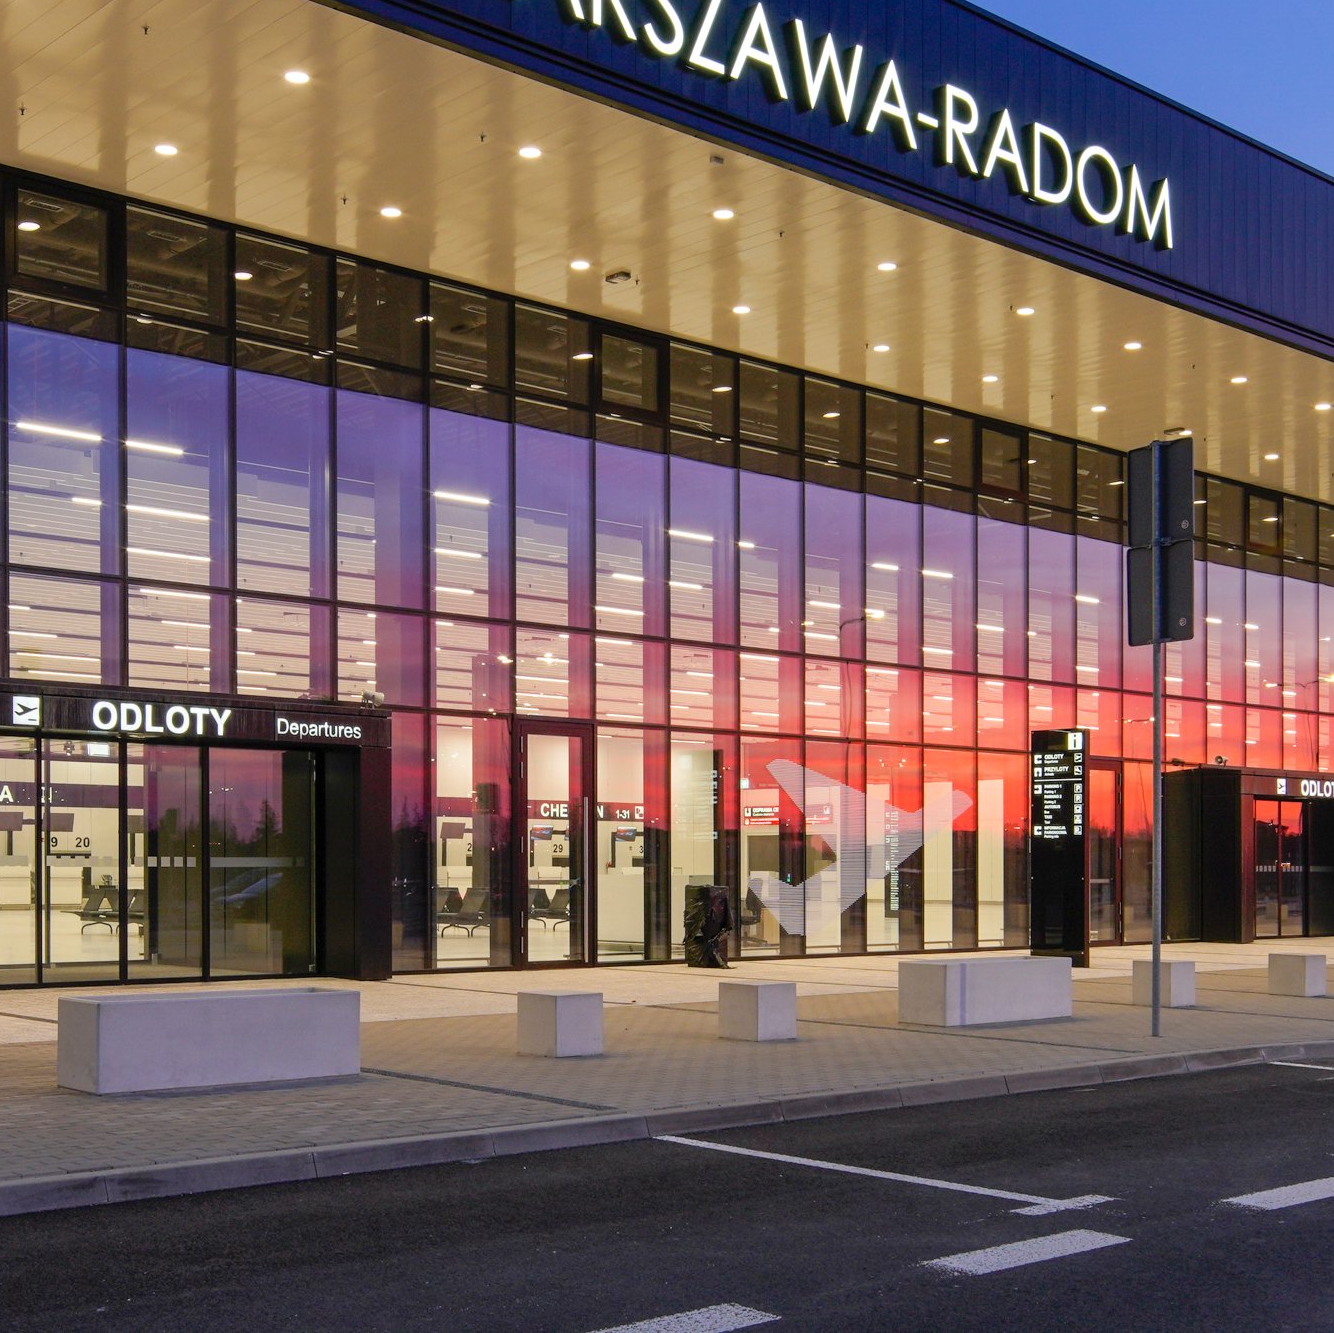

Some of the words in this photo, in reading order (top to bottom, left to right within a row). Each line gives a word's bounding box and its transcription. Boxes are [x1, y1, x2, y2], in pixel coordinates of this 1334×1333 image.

[92, 701, 231, 736] ODLOTY
[276, 718, 362, 739] Departures
[615, 809, 630, 819] 1-31
[51, 836, 58, 848] 9
[75, 837, 90, 848] 20
[552, 843, 564, 853] 29
